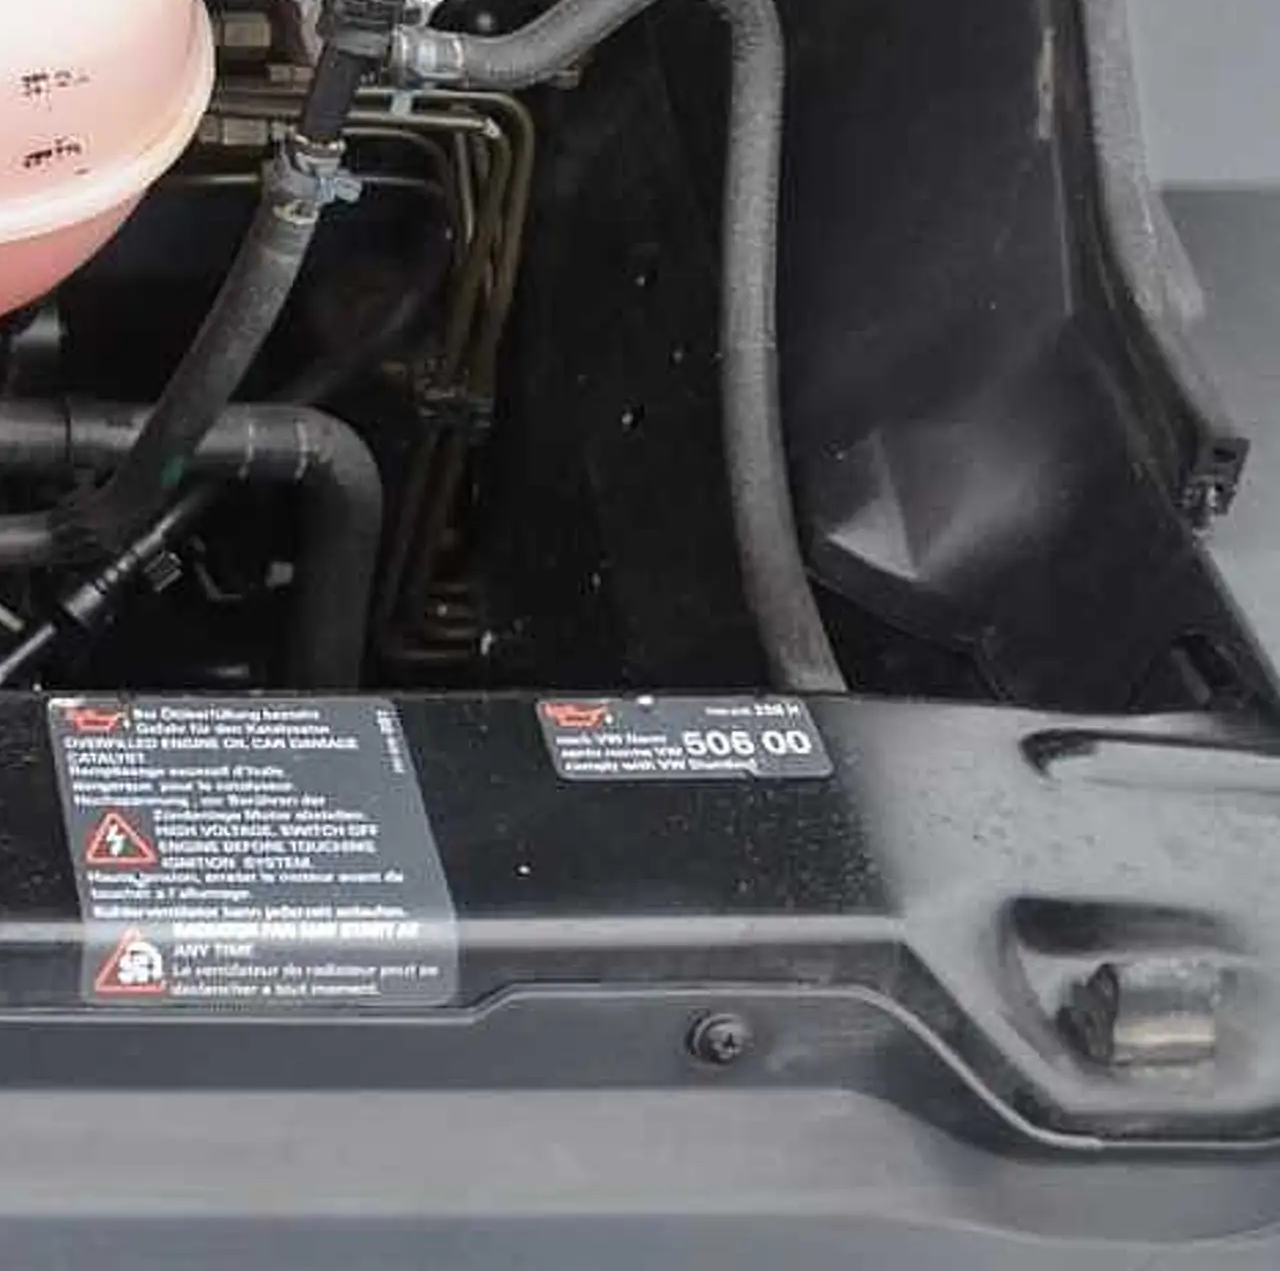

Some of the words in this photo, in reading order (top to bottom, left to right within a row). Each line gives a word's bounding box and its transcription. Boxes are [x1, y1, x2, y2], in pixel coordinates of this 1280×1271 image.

[161, 737, 219, 749] ENGINE
[251, 737, 286, 749] CAN
[761, 730, 811, 755] 00
[280, 824, 344, 836] SWITCH
[348, 824, 379, 836] OFF
[158, 840, 219, 852] ENGINE
[161, 857, 236, 868] IGNITION
[174, 944, 211, 958] ANY
[214, 943, 255, 956] TIME
